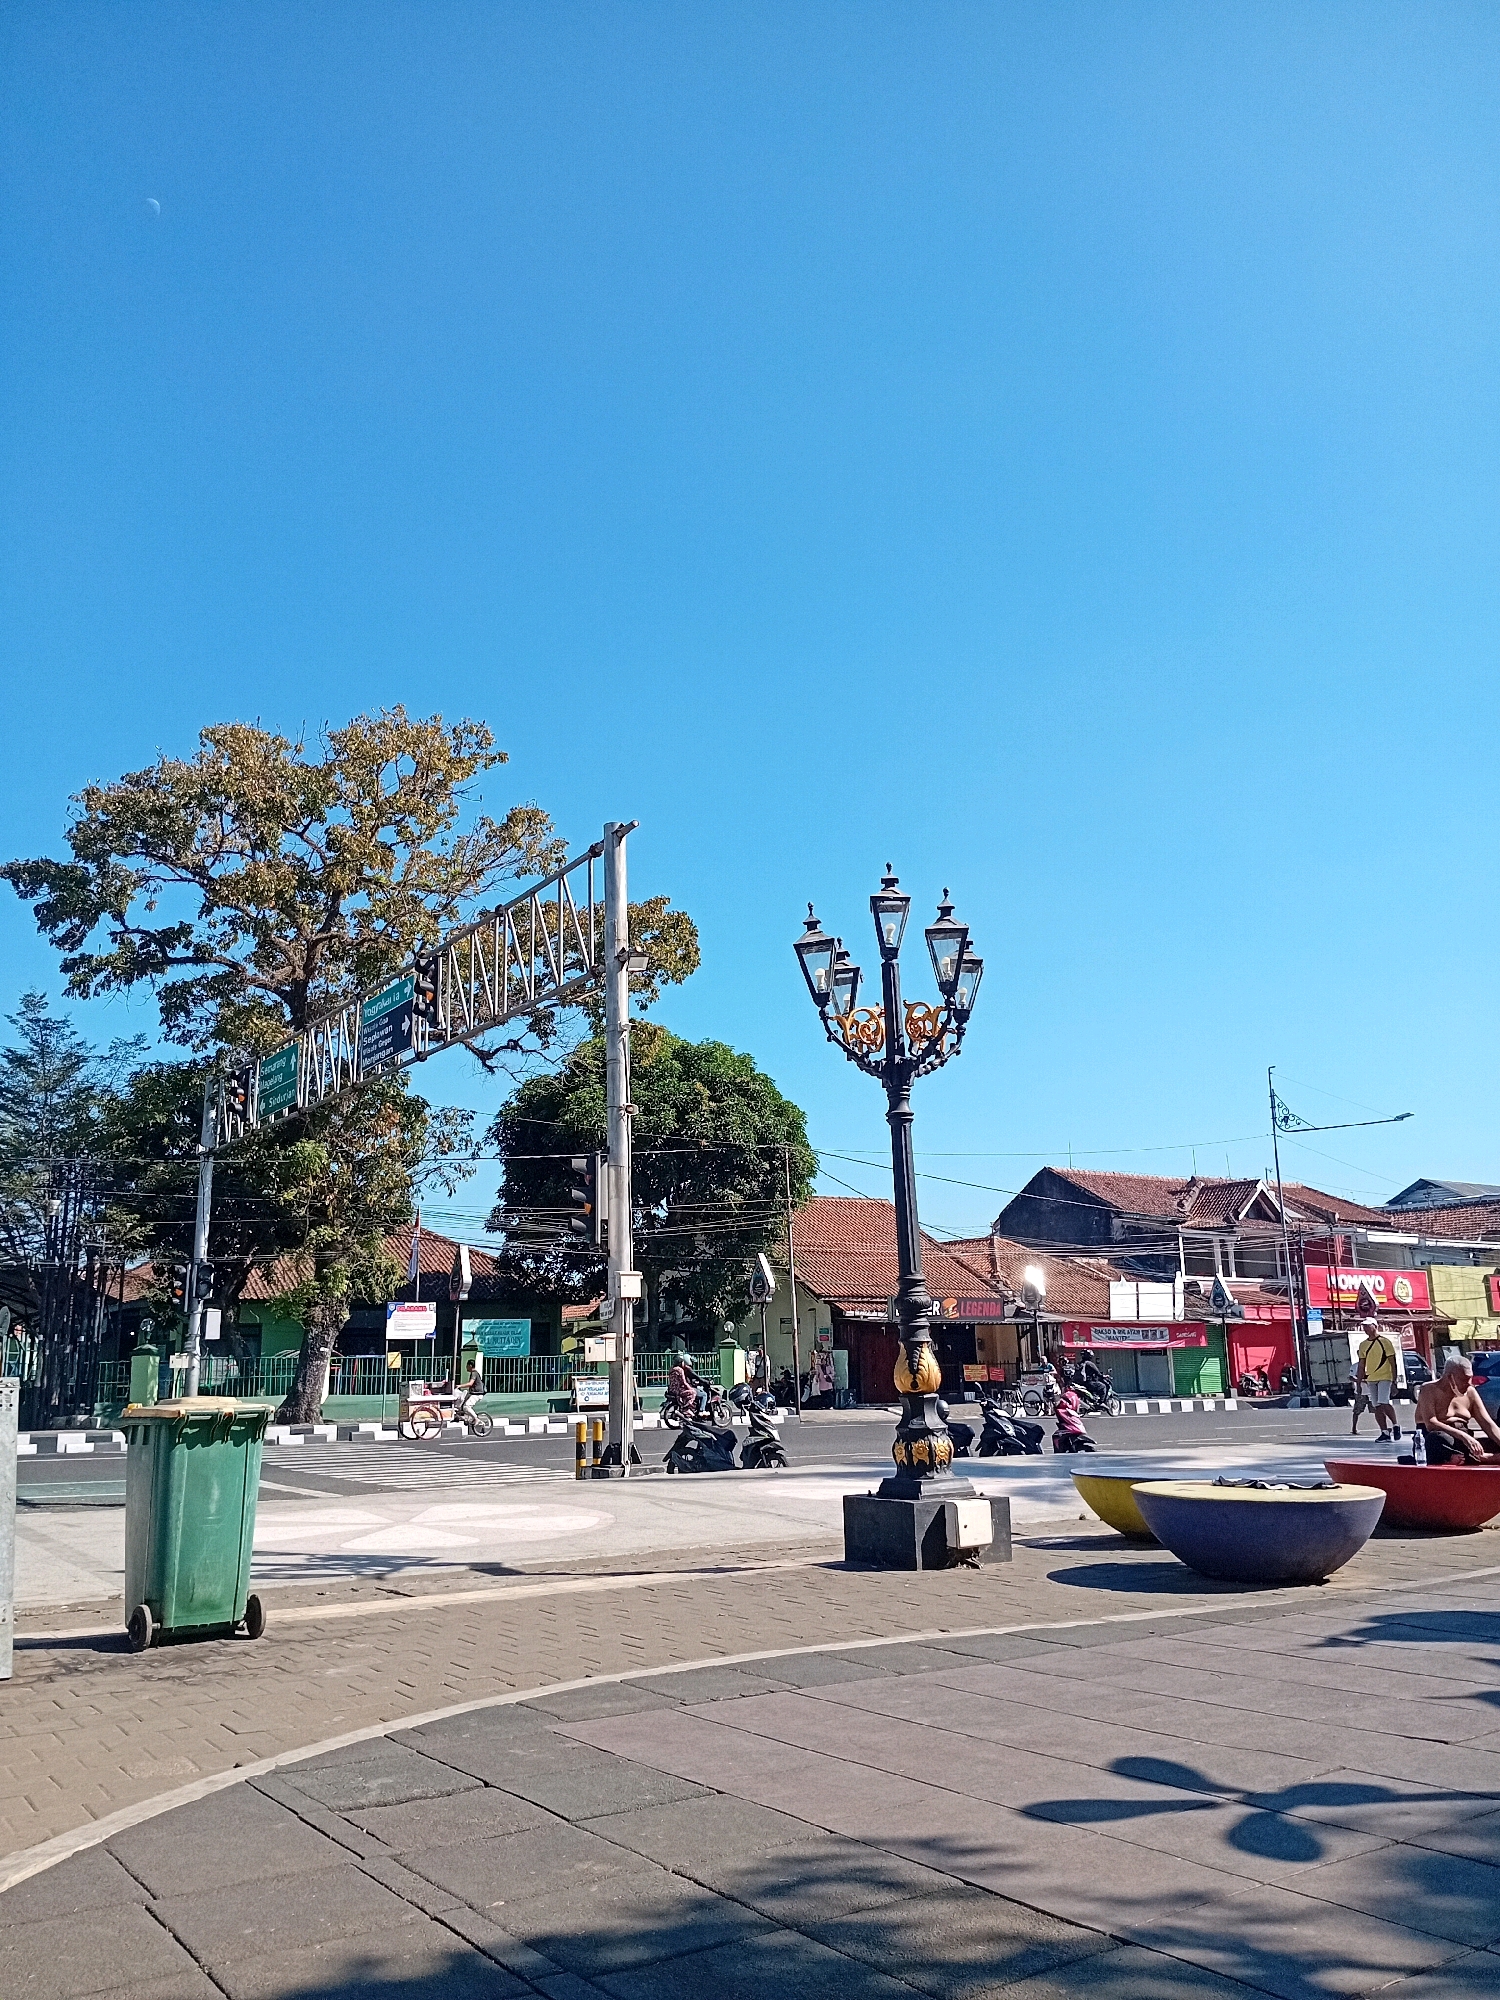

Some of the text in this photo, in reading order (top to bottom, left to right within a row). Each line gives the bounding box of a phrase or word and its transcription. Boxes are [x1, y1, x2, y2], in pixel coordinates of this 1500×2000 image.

[363, 1025, 393, 1046] Seplawan
[260, 1056, 287, 1077] Semarang
[362, 1046, 394, 1068] Menjangan
[268, 1088, 296, 1108] Sindurjan
[960, 1301, 1001, 1317] LEGENDA
